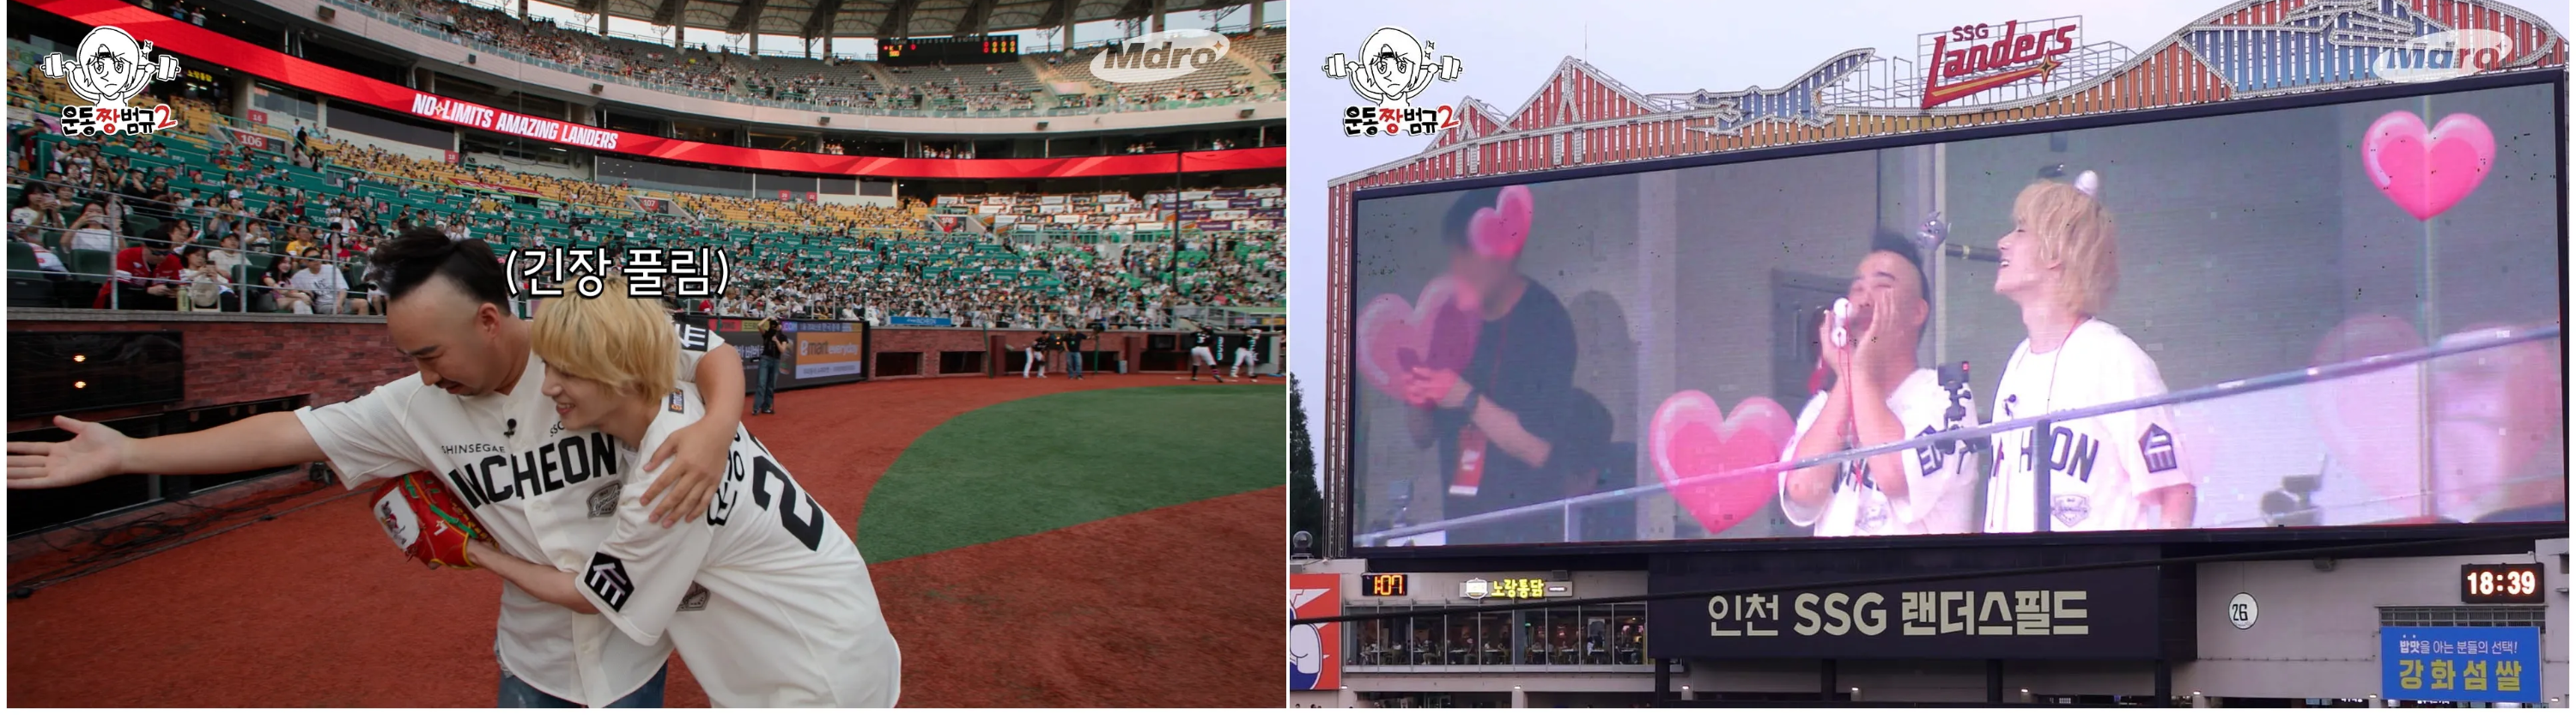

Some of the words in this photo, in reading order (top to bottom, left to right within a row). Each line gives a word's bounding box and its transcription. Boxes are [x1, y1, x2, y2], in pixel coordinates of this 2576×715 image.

[1952, 23, 1989, 42] SSG
[1921, 20, 2076, 110] Landers
[411, 94, 436, 115] NO
[441, 100, 494, 128] LIMITS
[495, 112, 559, 141] AMAZING
[561, 125, 618, 149] LANDERS
[240, 135, 263, 148] 106
[800, 340, 829, 356] emart
[441, 443, 506, 455] SHINSEGAE
[1491, 578, 1545, 599] 노랑통닭
[2467, 571, 2536, 595] 18:39
[1707, 592, 1779, 637] 인천
[1793, 591, 1887, 637] SSG
[1900, 589, 2089, 637] 랜더스필드
[2232, 603, 2248, 621] 26
[2399, 639, 2431, 655] 밥맛을
[2433, 640, 2454, 655] 아는
[2456, 640, 2488, 655] 분들의
[2491, 640, 2518, 655] 선택!
